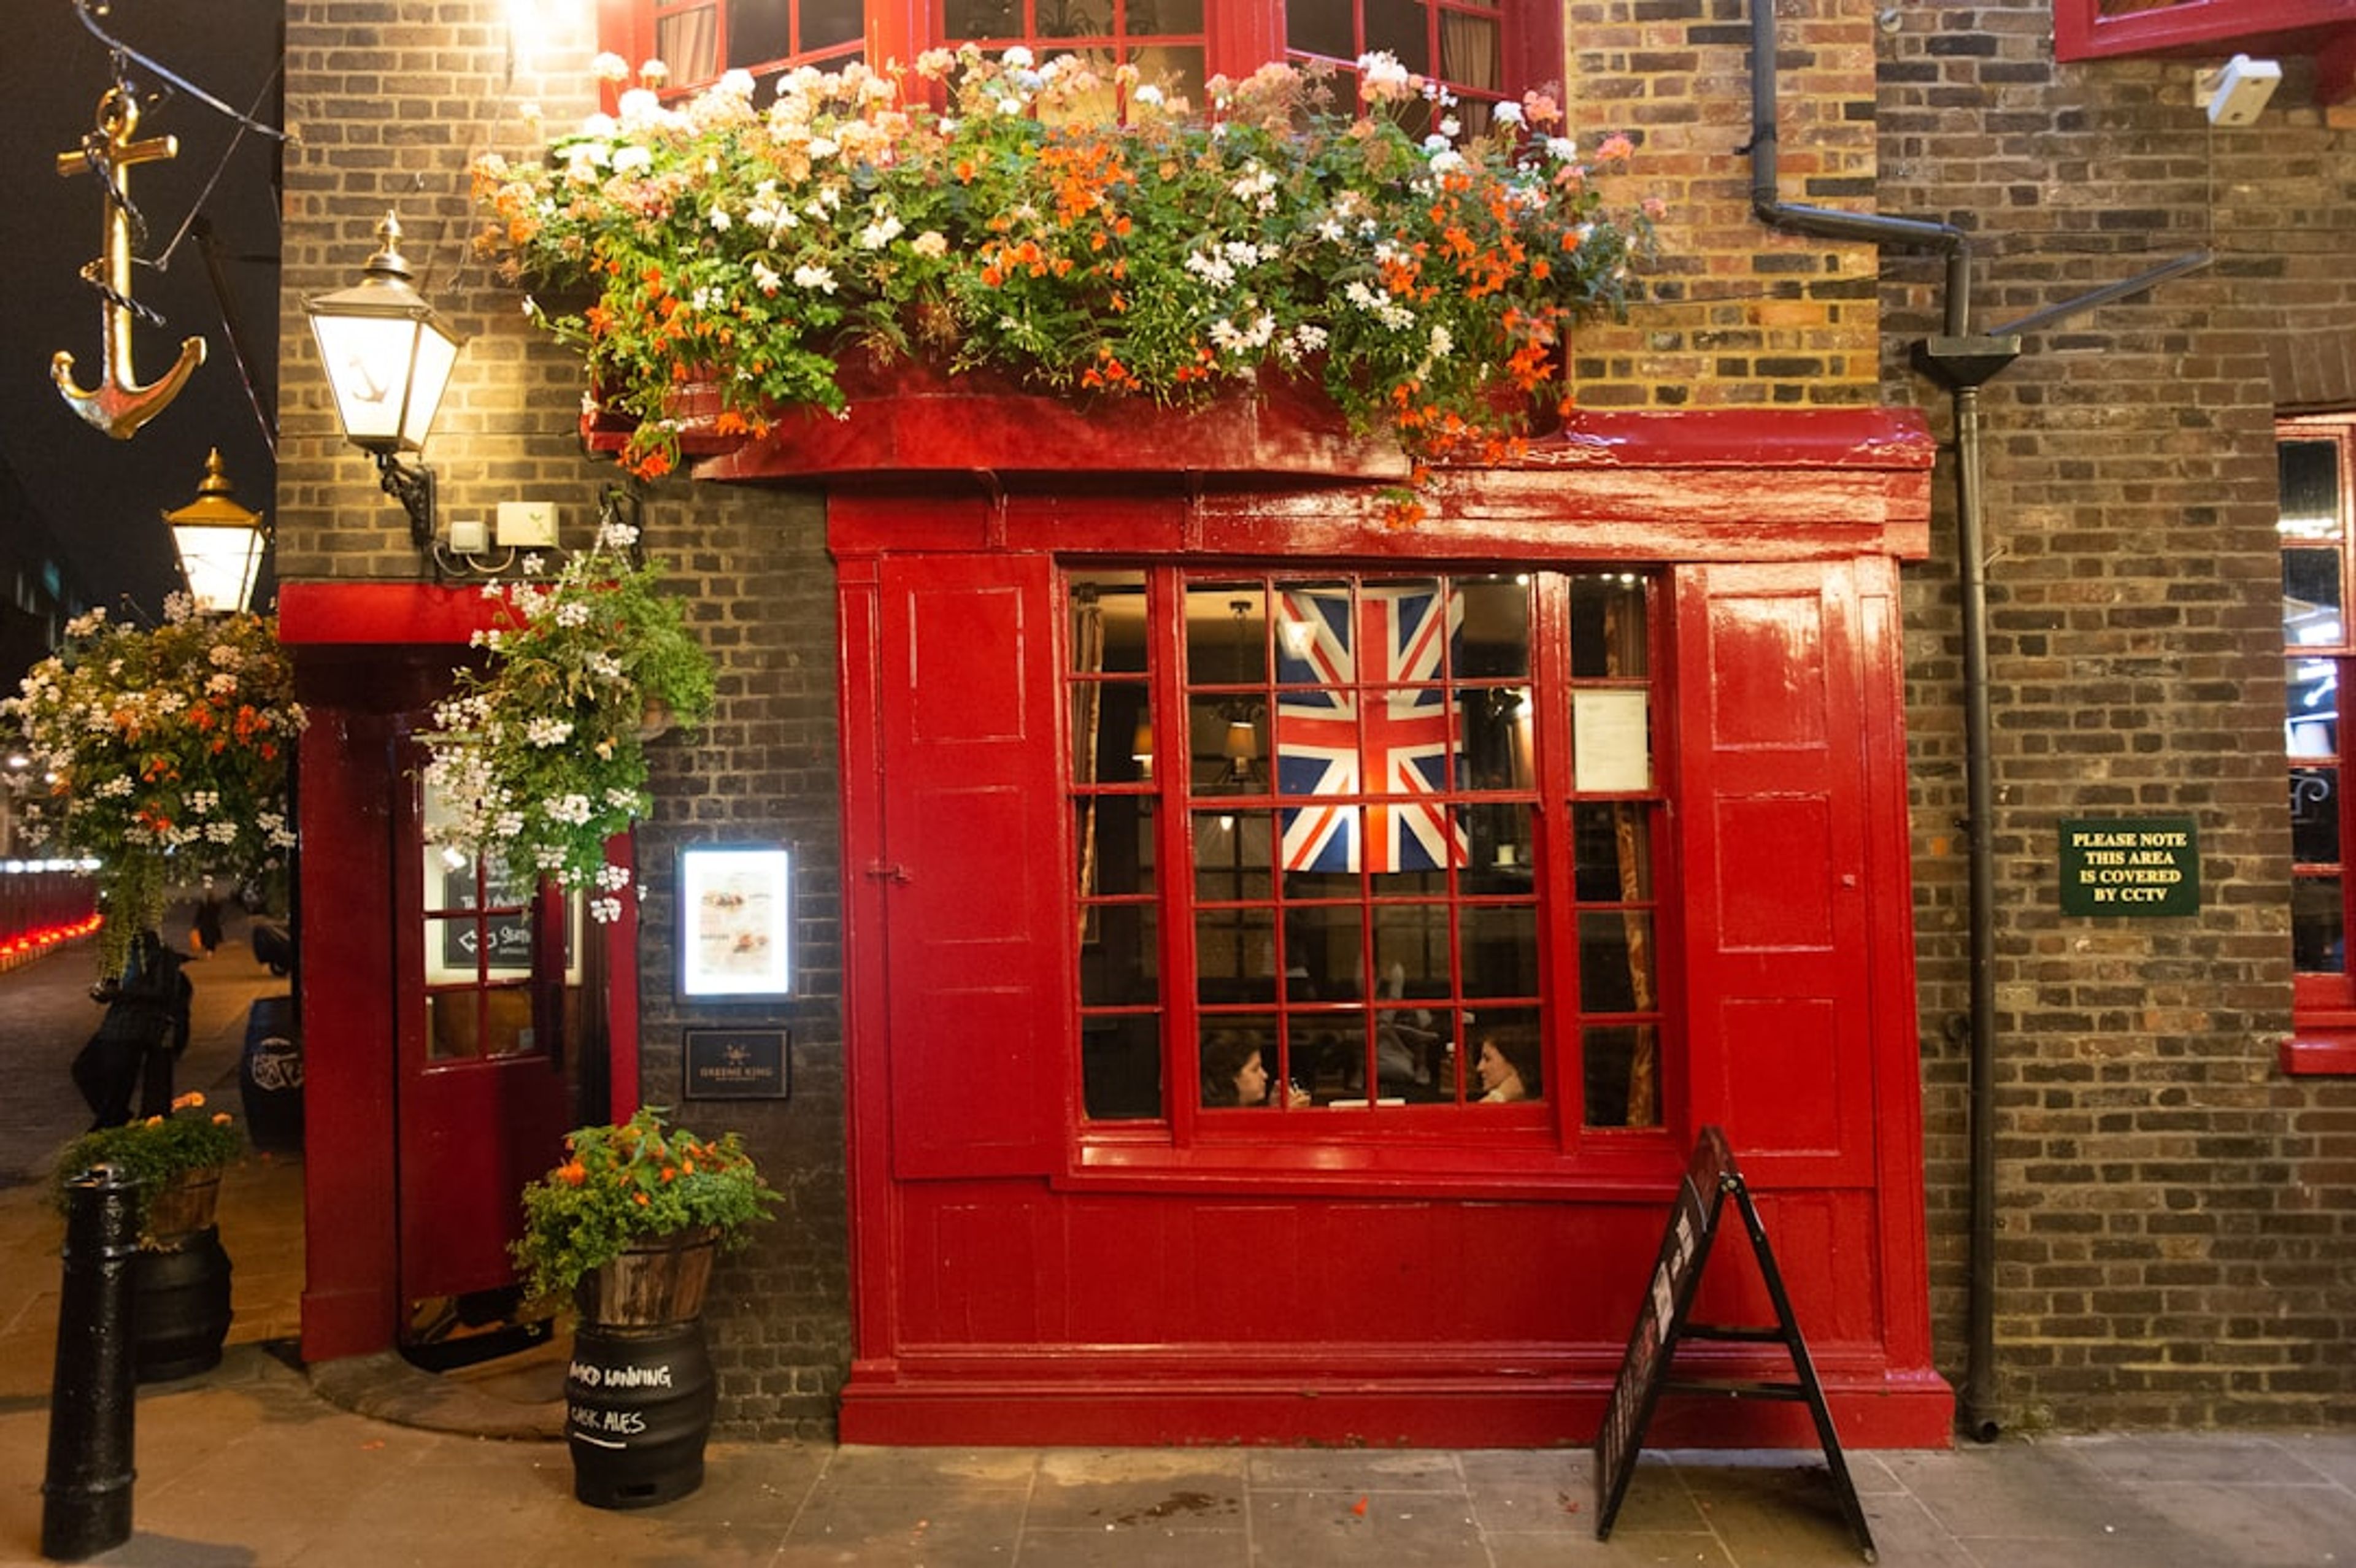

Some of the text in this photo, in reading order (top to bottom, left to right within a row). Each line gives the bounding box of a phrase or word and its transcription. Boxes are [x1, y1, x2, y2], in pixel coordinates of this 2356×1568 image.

[2073, 833, 2187, 847] PLEASE NOTE
[2085, 851, 2175, 864] THIS AREA
[2080, 870, 2182, 883] IS COVERED
[2094, 888, 2168, 901] BY CCTV
[604, 1411, 646, 1434] ALES
